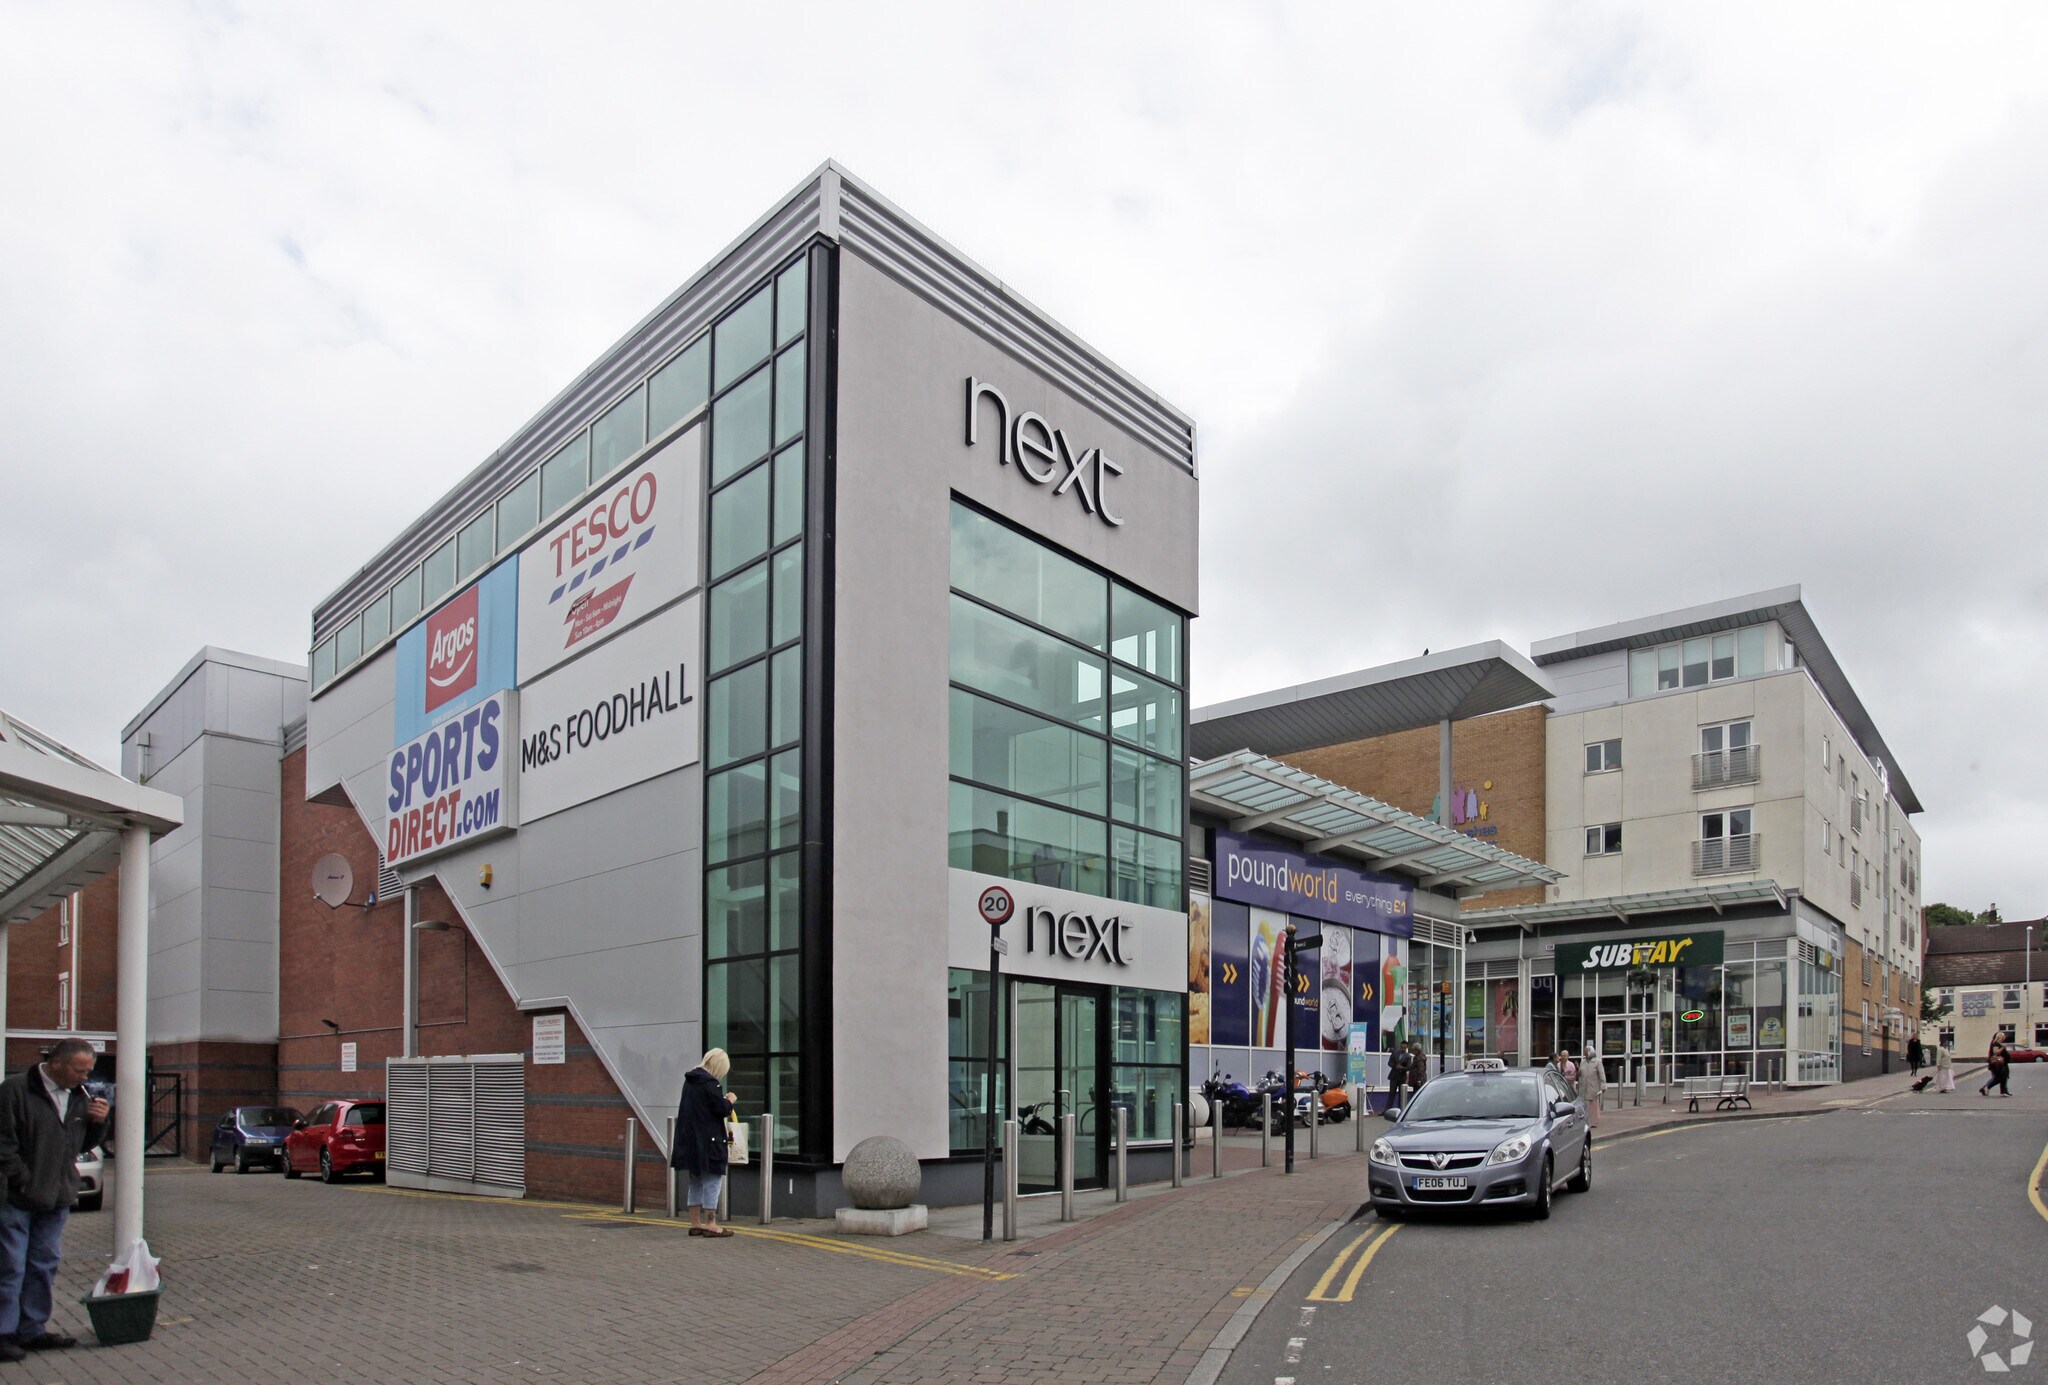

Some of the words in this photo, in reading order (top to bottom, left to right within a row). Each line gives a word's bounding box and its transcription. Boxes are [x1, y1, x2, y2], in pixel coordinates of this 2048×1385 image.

[965, 376, 1124, 527] next
[550, 472, 657, 578] TESCO
[430, 616, 475, 669] Argos
[522, 723, 561, 773] M&S
[567, 663, 693, 754] FOODHALL
[388, 699, 500, 813] SPORTS
[387, 788, 499, 863] DIRECT.COM
[984, 897, 1007, 911] 20
[1228, 853, 1338, 904] poundworld
[1345, 890, 1393, 914] everything
[1393, 900, 1407, 914] £1
[1026, 906, 1135, 965] next
[1582, 937, 1693, 969] SUBWAY
[1294, 996, 1319, 1007] undworld
[1962, 1001, 1996, 1009] SOCIAL
[1962, 1008, 1986, 1017] CLUB
[1418, 1178, 1444, 1188] FE06
[1446, 1178, 1466, 1187] TUJ
